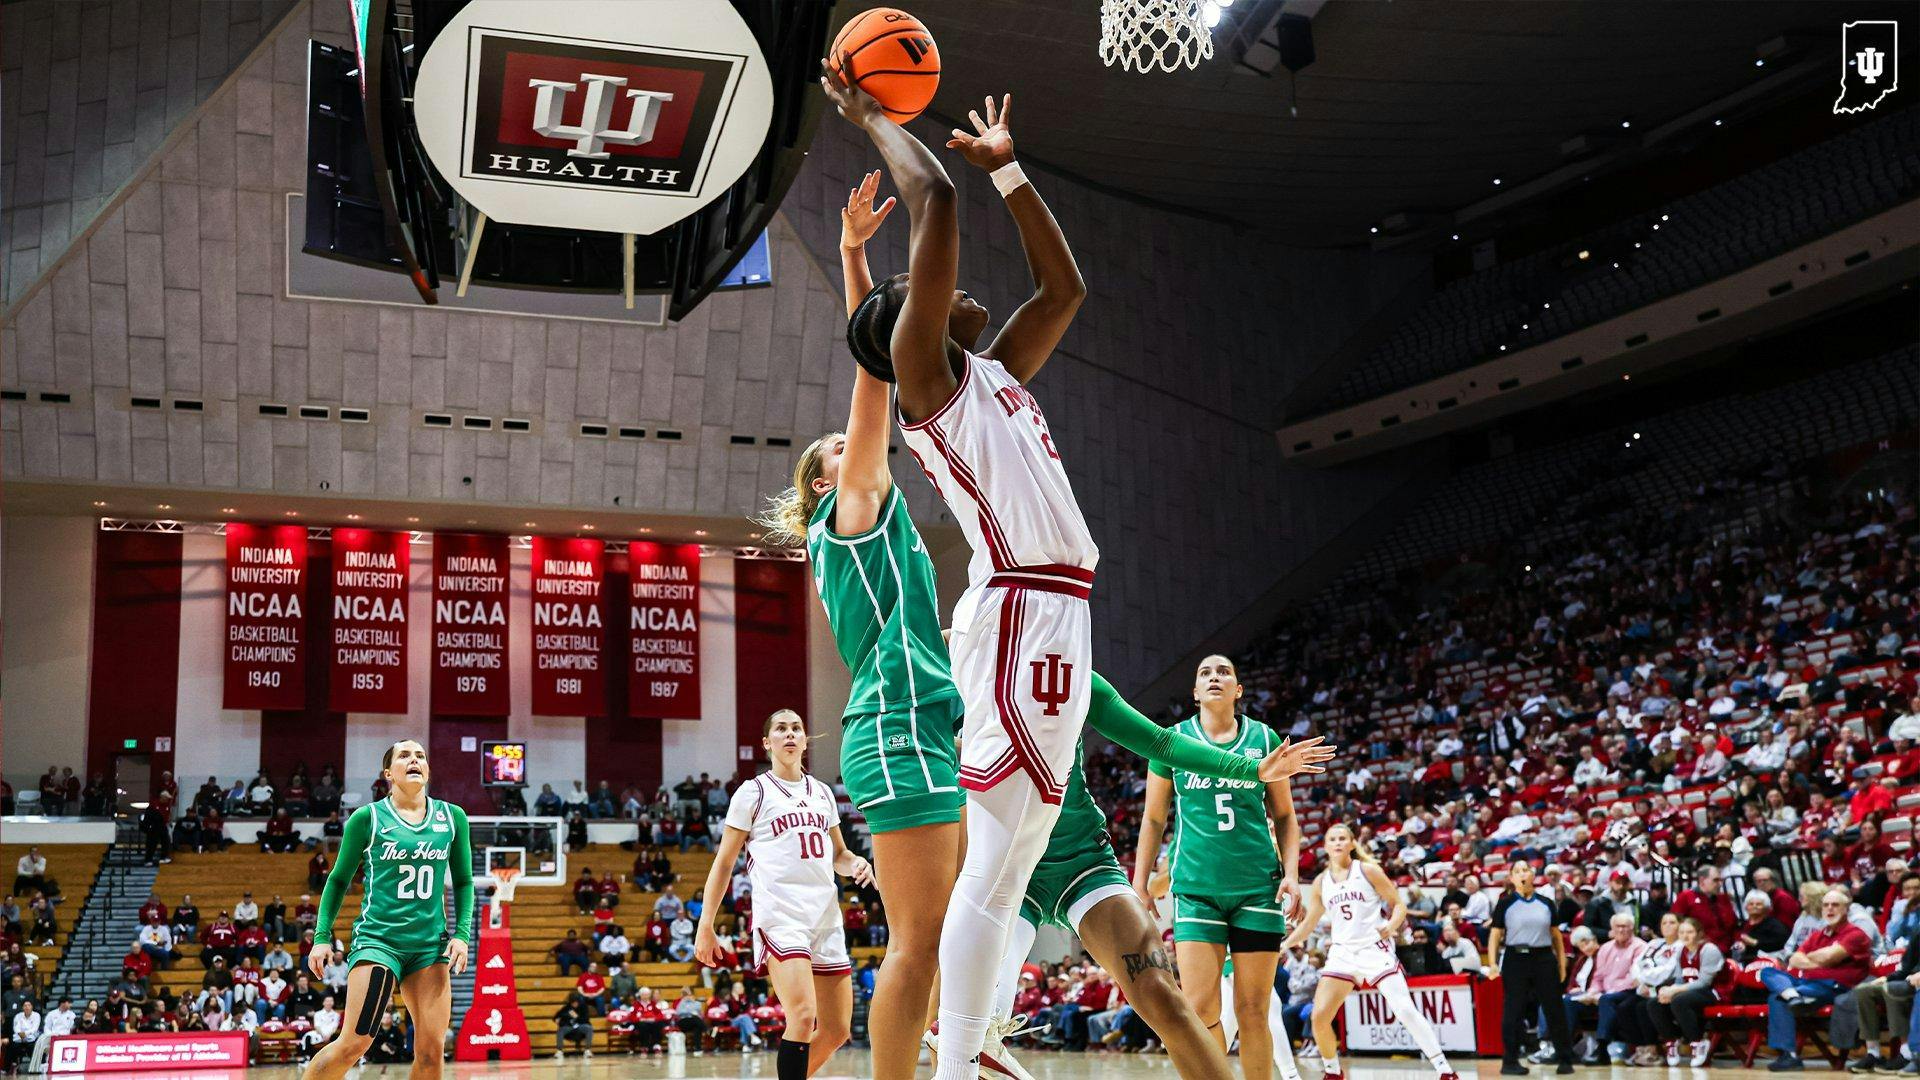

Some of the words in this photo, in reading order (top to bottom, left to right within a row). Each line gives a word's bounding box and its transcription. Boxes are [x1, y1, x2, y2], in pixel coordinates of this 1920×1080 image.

[489, 153, 682, 185] HEALTH
[241, 547, 293, 564] INDIANA
[346, 551, 396, 568] INDIANA
[447, 557, 496, 572] INDIANA
[545, 560, 593, 577] INDIANA
[641, 564, 687, 580] INDIANA
[232, 567, 300, 584] UNIVERSITY
[337, 571, 403, 589] UNIVERSITY
[439, 576, 504, 592] UNIVERSITY
[537, 579, 599, 595] UNIVERSITY
[633, 584, 694, 599] UNIVERSITY
[230, 592, 301, 618] NCAA
[335, 596, 405, 622] NCAA
[436, 600, 505, 625] NCAA
[535, 603, 601, 627] NCAA
[631, 607, 696, 631] NCAA
[231, 626, 299, 642] BASKETBALL
[336, 629, 401, 646] BASKETBALL
[438, 632, 502, 649] BASKETBALL
[537, 634, 599, 651] BASKETBALL
[232, 646, 295, 662] CHAMPIONS
[633, 638, 694, 655] BASKETBALL
[338, 649, 399, 666] CHAMPIONS
[440, 652, 500, 668] CHAMPIONS
[539, 654, 597, 670] CHAMPIONS
[636, 658, 693, 673] CHAMPIONS
[249, 671, 280, 687] 1940
[353, 674, 383, 689] 1953
[458, 677, 486, 692] 1976
[557, 679, 581, 693] 1981
[652, 682, 678, 697] 1987
[1184, 771, 1211, 790] The
[1215, 793, 1235, 831] 5
[380, 841, 408, 860] The
[411, 841, 449, 860] Herd
[798, 831, 825, 860] 10
[397, 864, 435, 900] 20
[1328, 891, 1366, 910] NDIANA
[1340, 904, 1353, 921] 5
[1359, 989, 1456, 1025] INDNA
[470, 1033, 520, 1045] Smithville
[1370, 1026, 1446, 1047] BASKEL
[127, 1044, 173, 1053] Healthcare
[174, 1044, 190, 1052] and
[191, 1043, 219, 1052] Sports
[95, 1054, 134, 1063] Medicine
[135, 1053, 170, 1062] Provider
[171, 1053, 181, 1061] of
